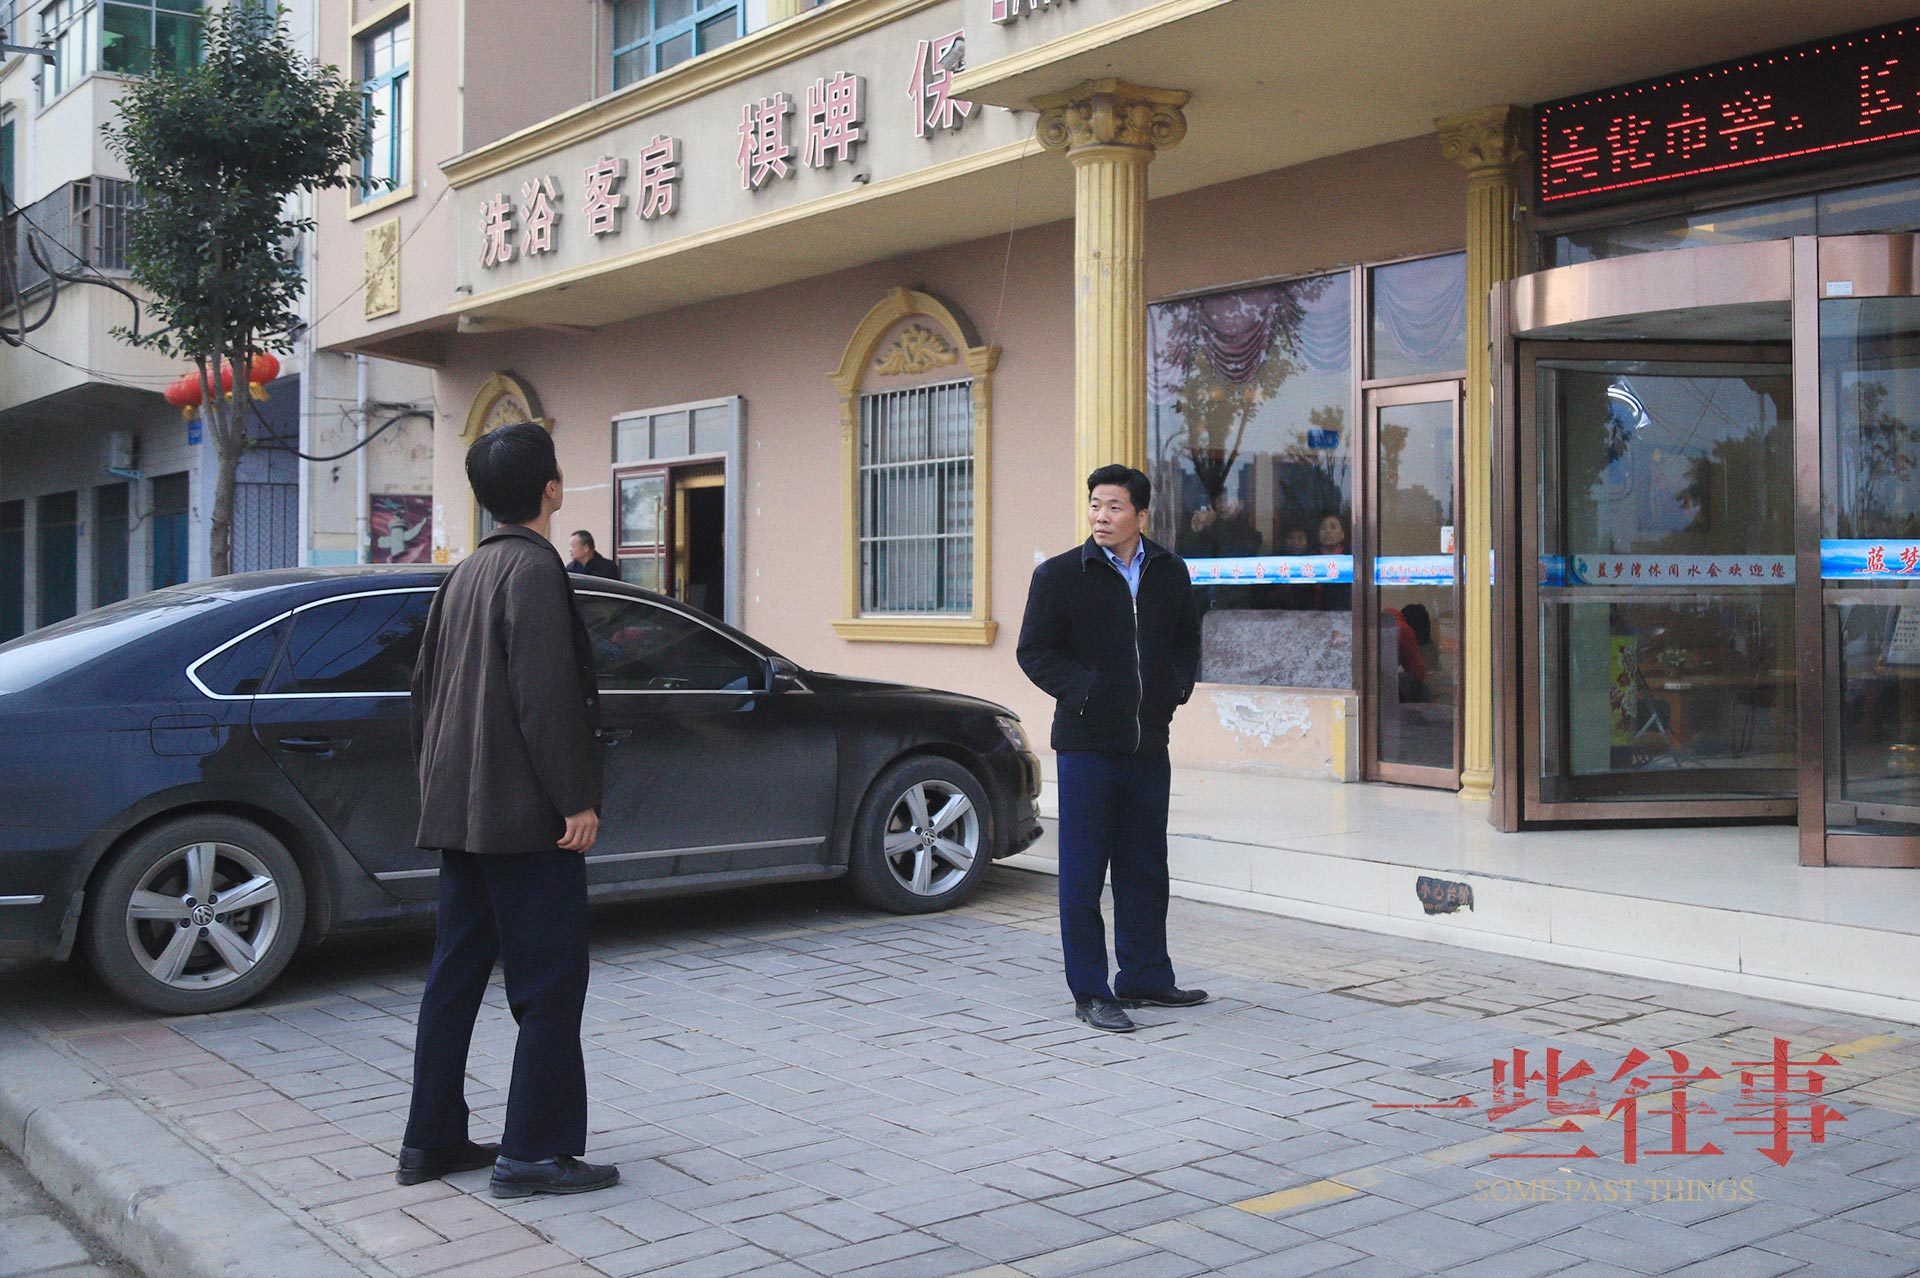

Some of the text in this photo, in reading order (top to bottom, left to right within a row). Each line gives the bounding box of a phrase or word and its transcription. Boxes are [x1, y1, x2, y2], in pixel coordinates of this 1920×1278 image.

[479, 28, 973, 268] 洗浴 客房 棋牌 保
[1596, 561, 1786, 580] 蓝梦湾休闲水会欢迎您
[1863, 545, 1920, 574] 蓝梦
